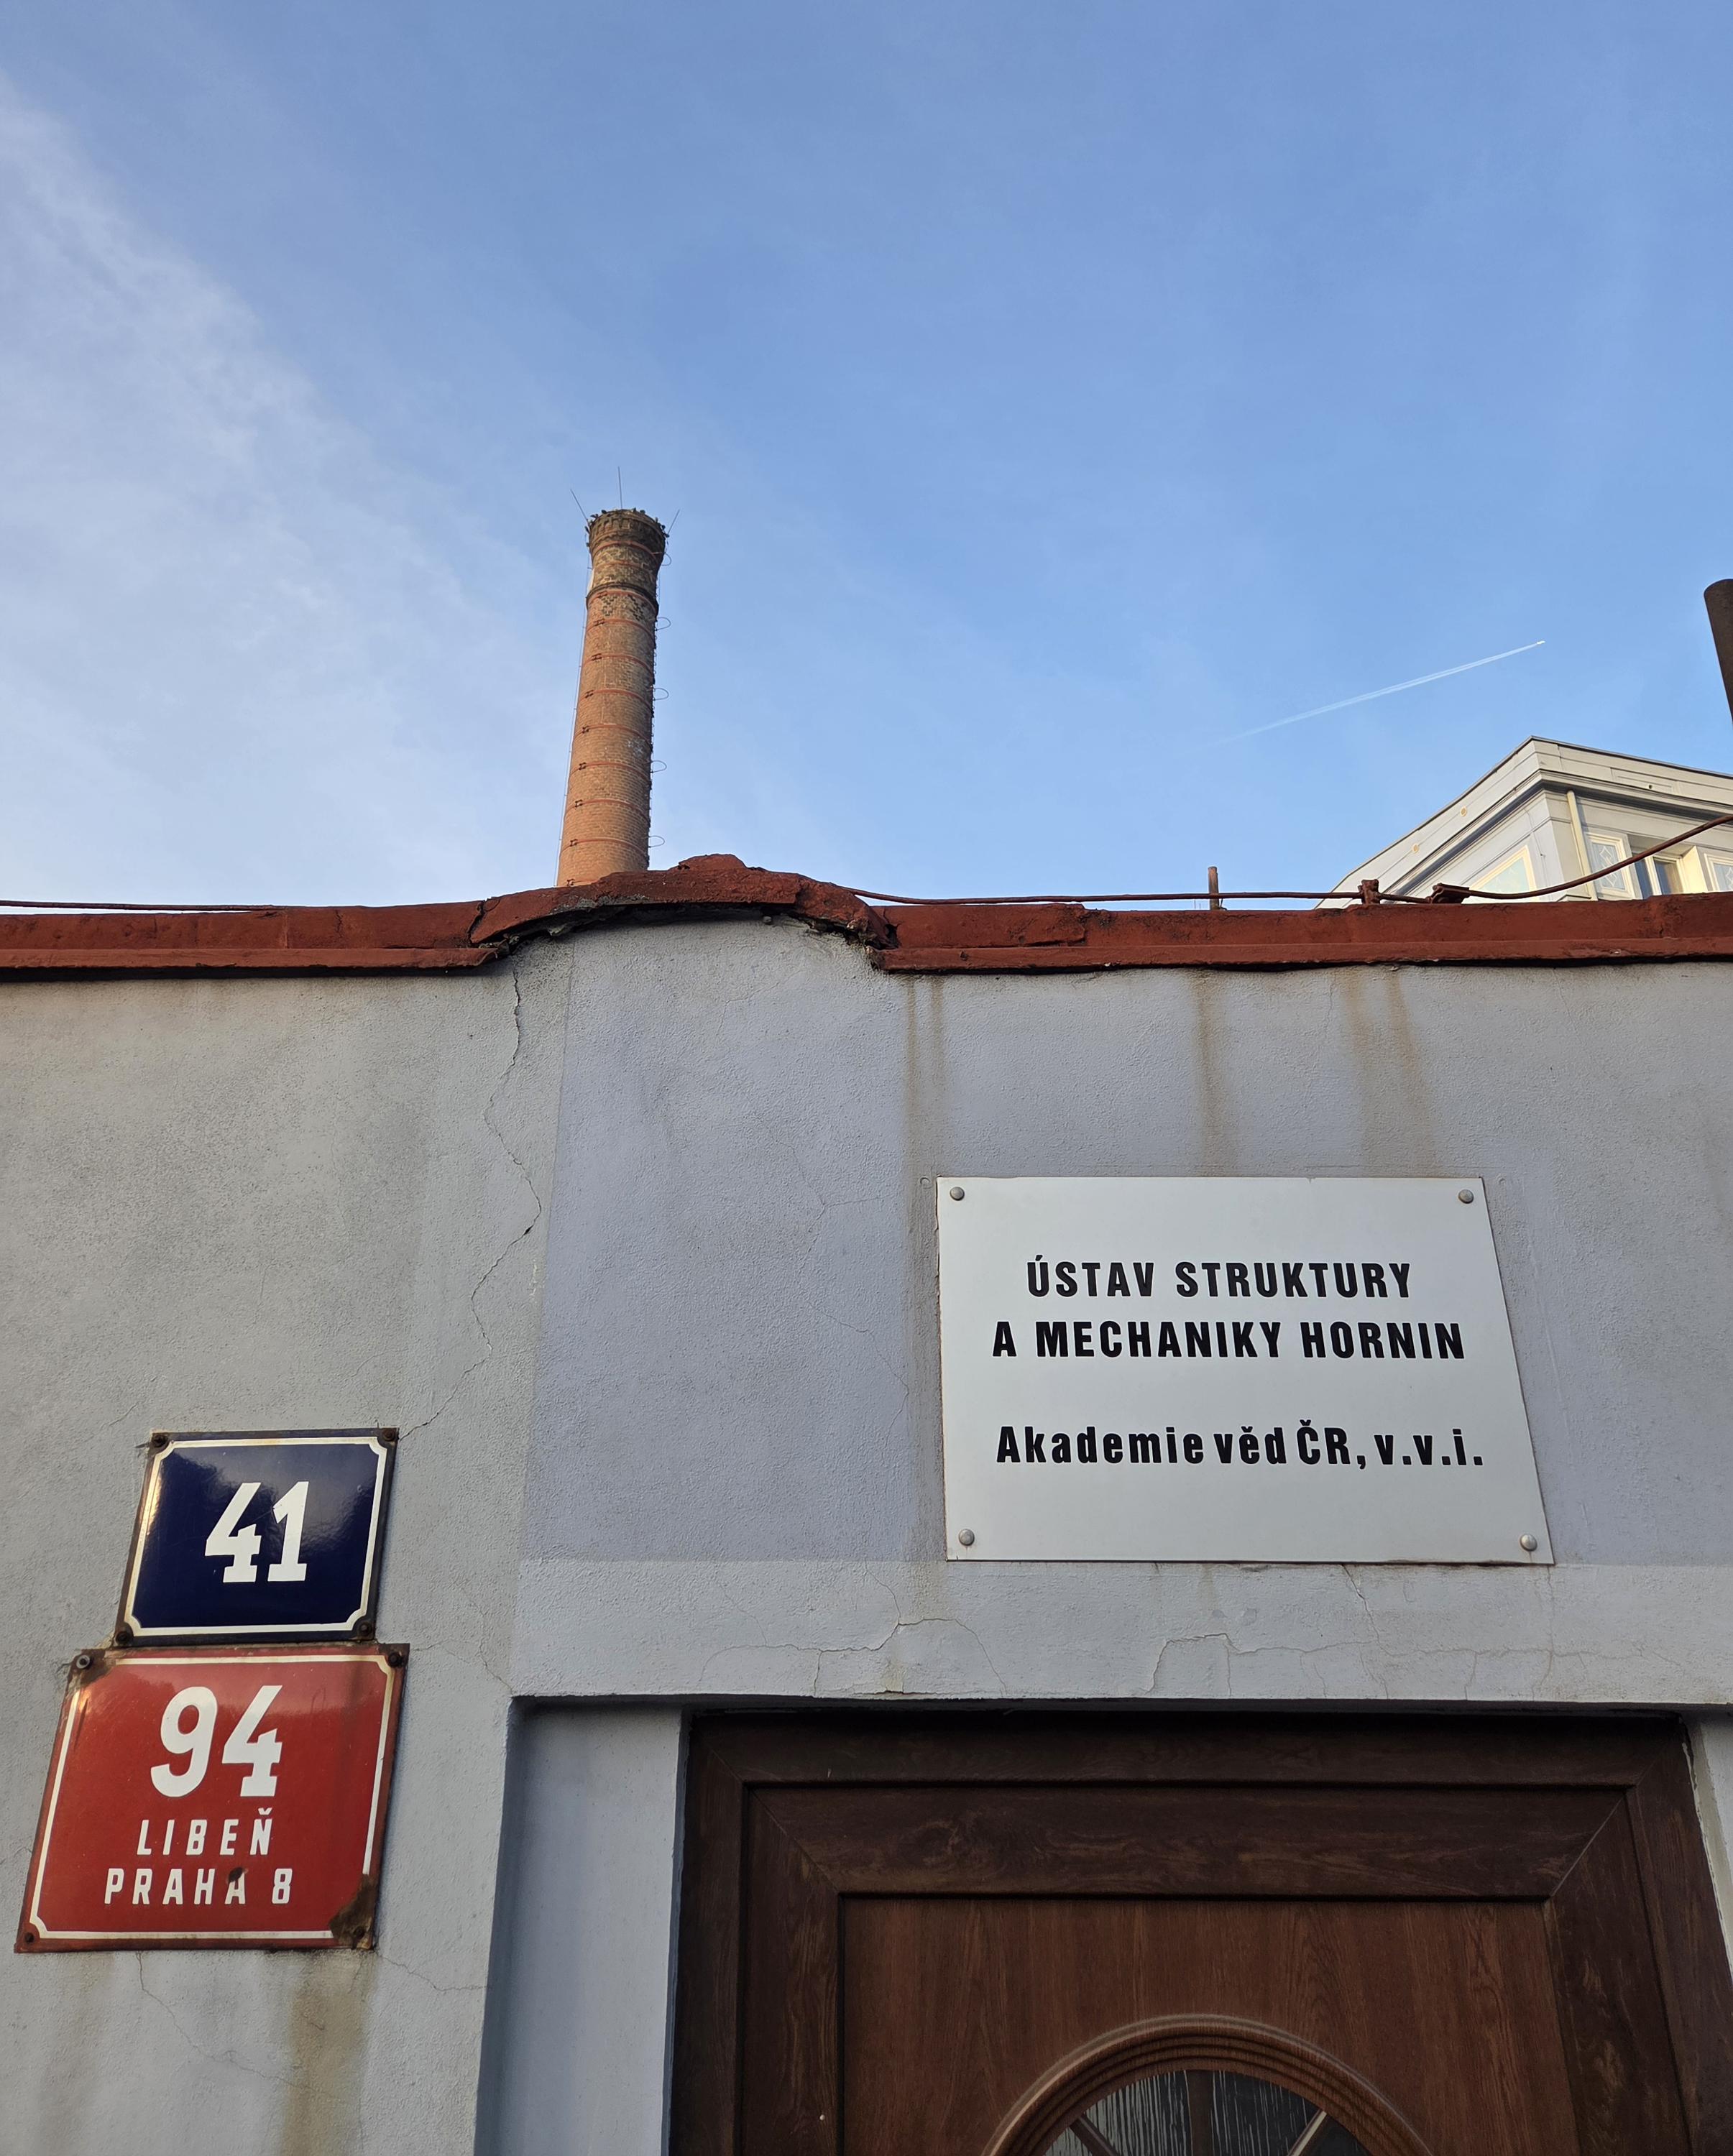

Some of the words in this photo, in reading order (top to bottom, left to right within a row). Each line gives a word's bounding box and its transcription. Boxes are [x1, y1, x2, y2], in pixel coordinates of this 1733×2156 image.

[1027, 1254, 1154, 1297] ÚSTAV
[1175, 1261, 1411, 1298] STRUKTURY
[992, 1321, 1017, 1357] A
[1035, 1320, 1281, 1358] MECHANIKY
[1300, 1321, 1465, 1359] HORNIN
[996, 1426, 1204, 1465] Akademie
[1217, 1426, 1287, 1465] věd
[1296, 1419, 1366, 1470] ČR,
[1376, 1428, 1484, 1466] v.v.i.
[204, 1481, 310, 1583] 41
[150, 1685, 283, 1797] 94
[137, 1807, 272, 1856] LIBEŇ
[104, 1868, 247, 1905] PRAHA
[271, 1868, 293, 1904] 8
